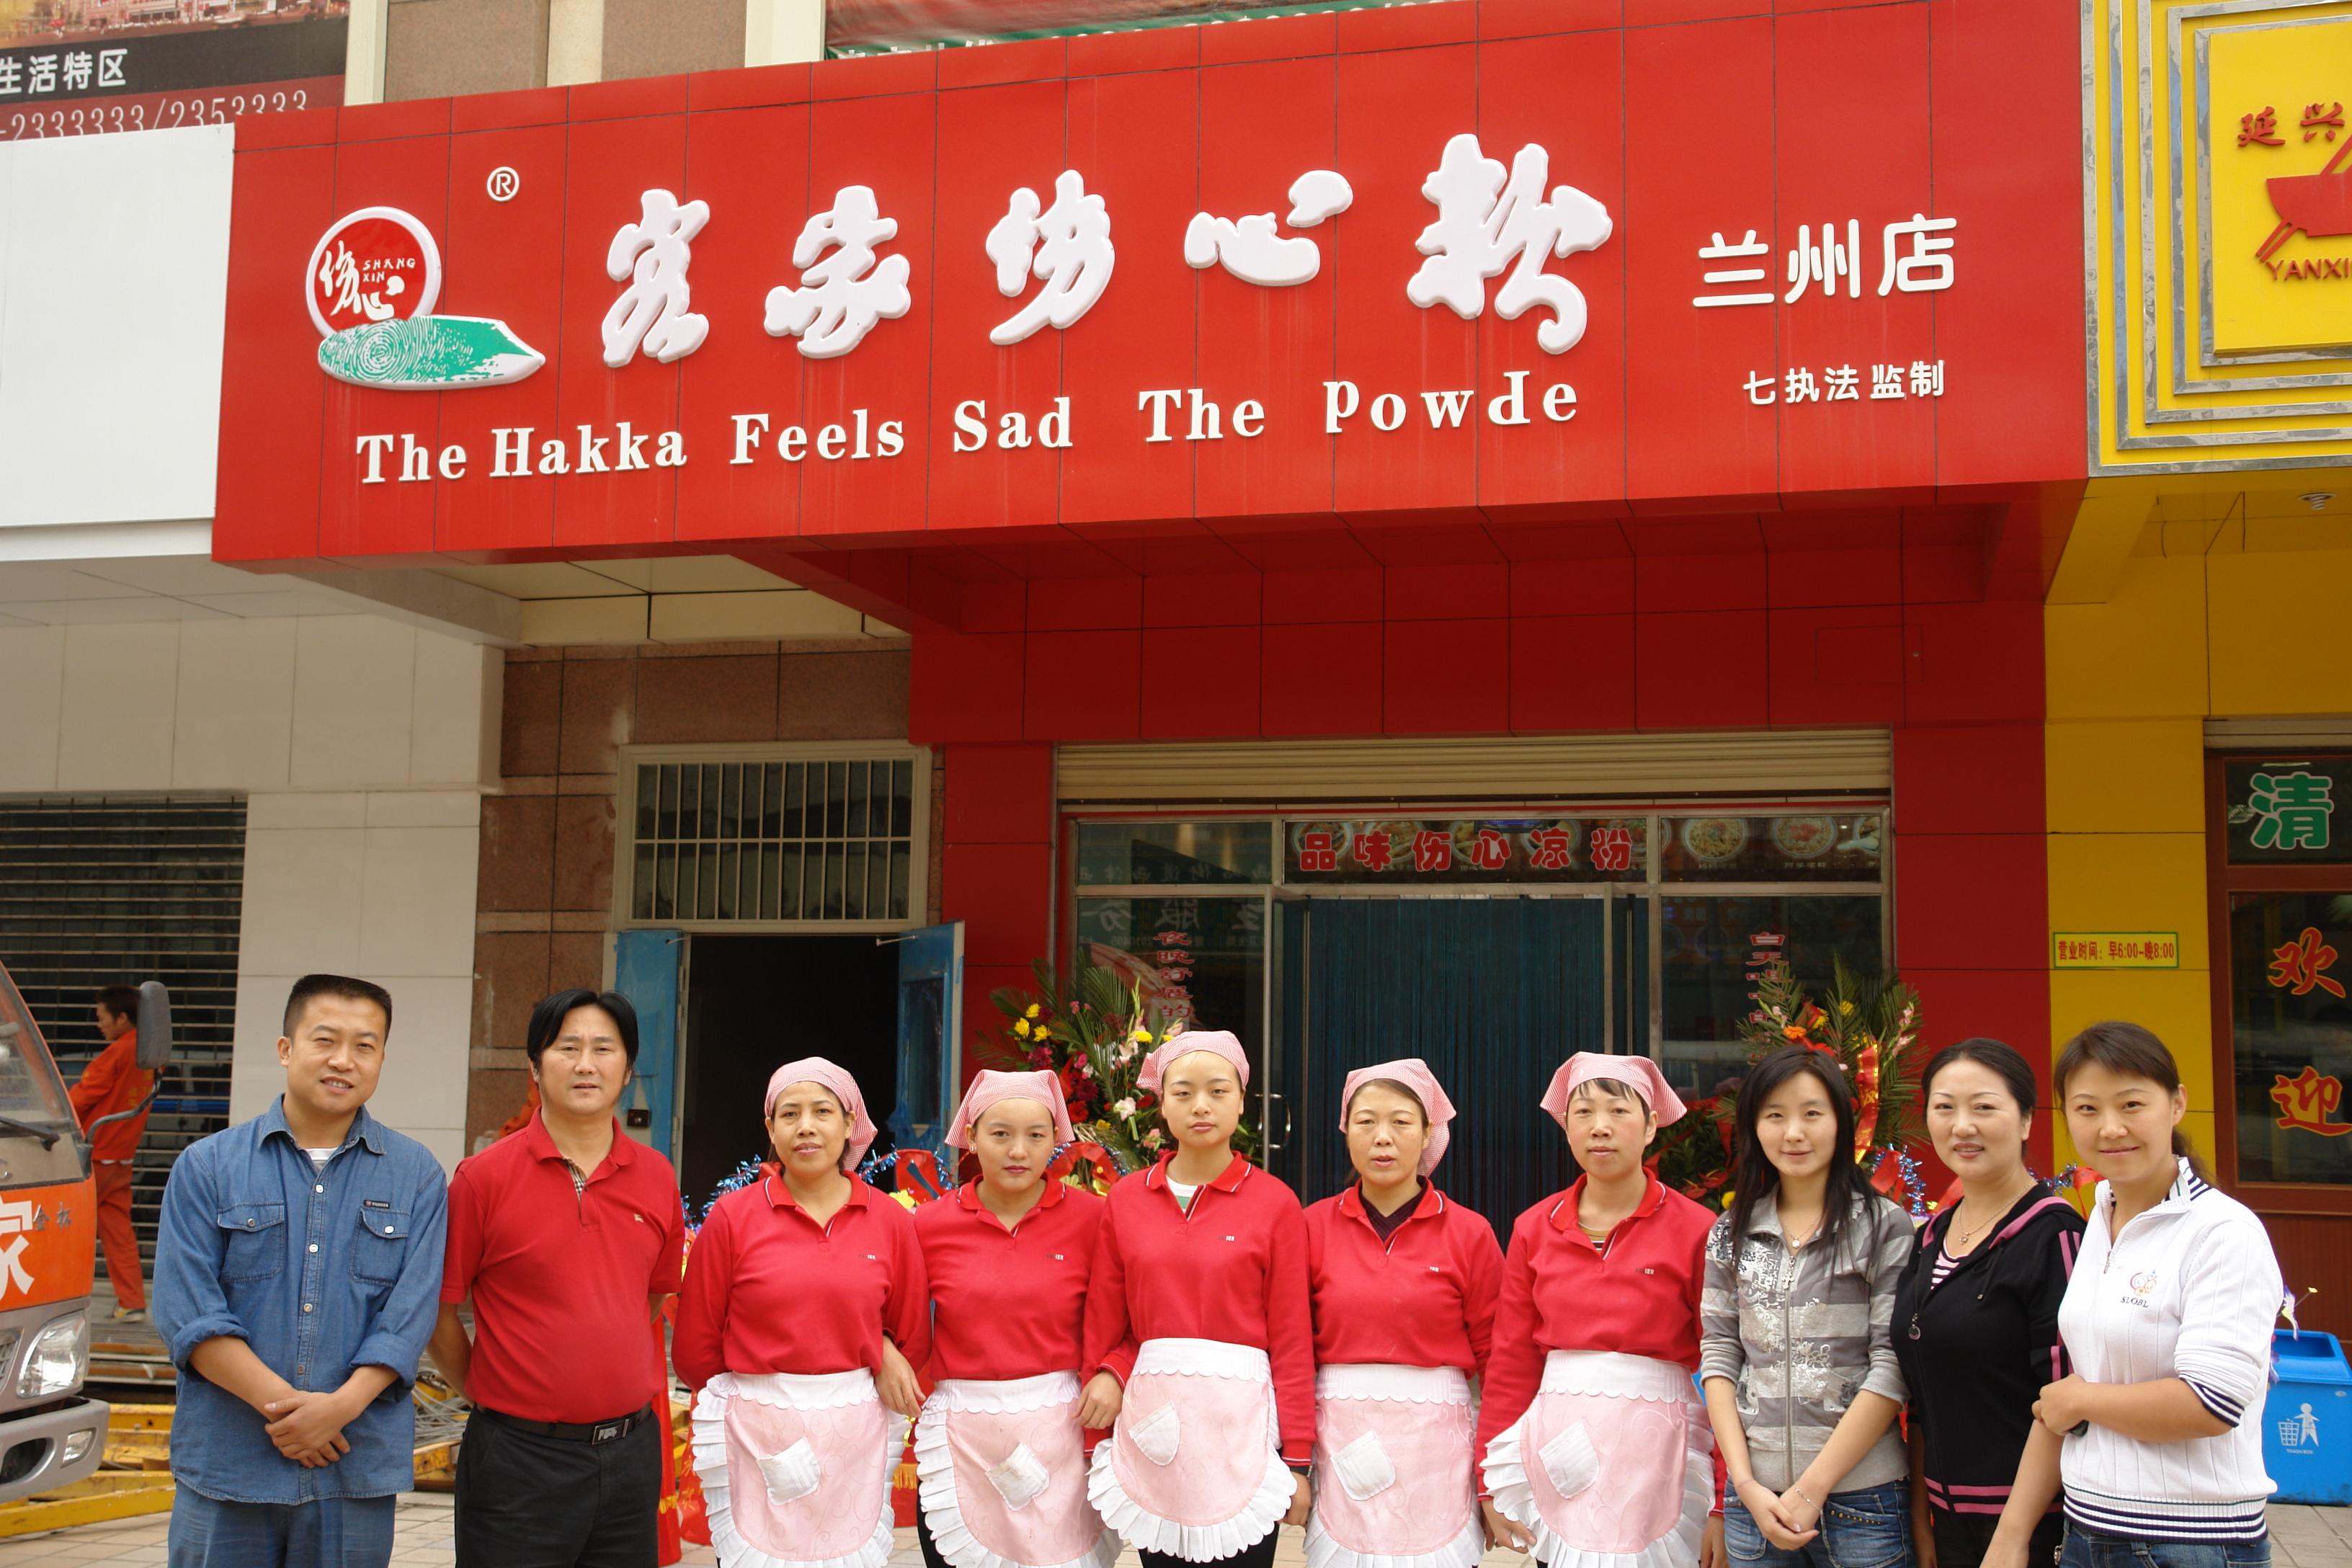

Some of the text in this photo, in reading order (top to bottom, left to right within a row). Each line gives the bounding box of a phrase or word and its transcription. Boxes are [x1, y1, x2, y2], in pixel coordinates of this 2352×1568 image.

[0, 48, 128, 94] 生活特区
[362, 257, 416, 271] SHANG
[362, 271, 386, 283] XIN
[1693, 213, 1957, 307] 兰州店
[356, 433, 467, 484] The
[489, 422, 687, 478] Hakka
[729, 408, 905, 465] Feels
[953, 396, 1074, 453] Sad
[1138, 388, 1265, 442] The
[2248, 771, 2335, 851] 清
[1299, 827, 1633, 872] 品味伤心凉粉
[2267, 926, 2352, 1136] 欢迎
